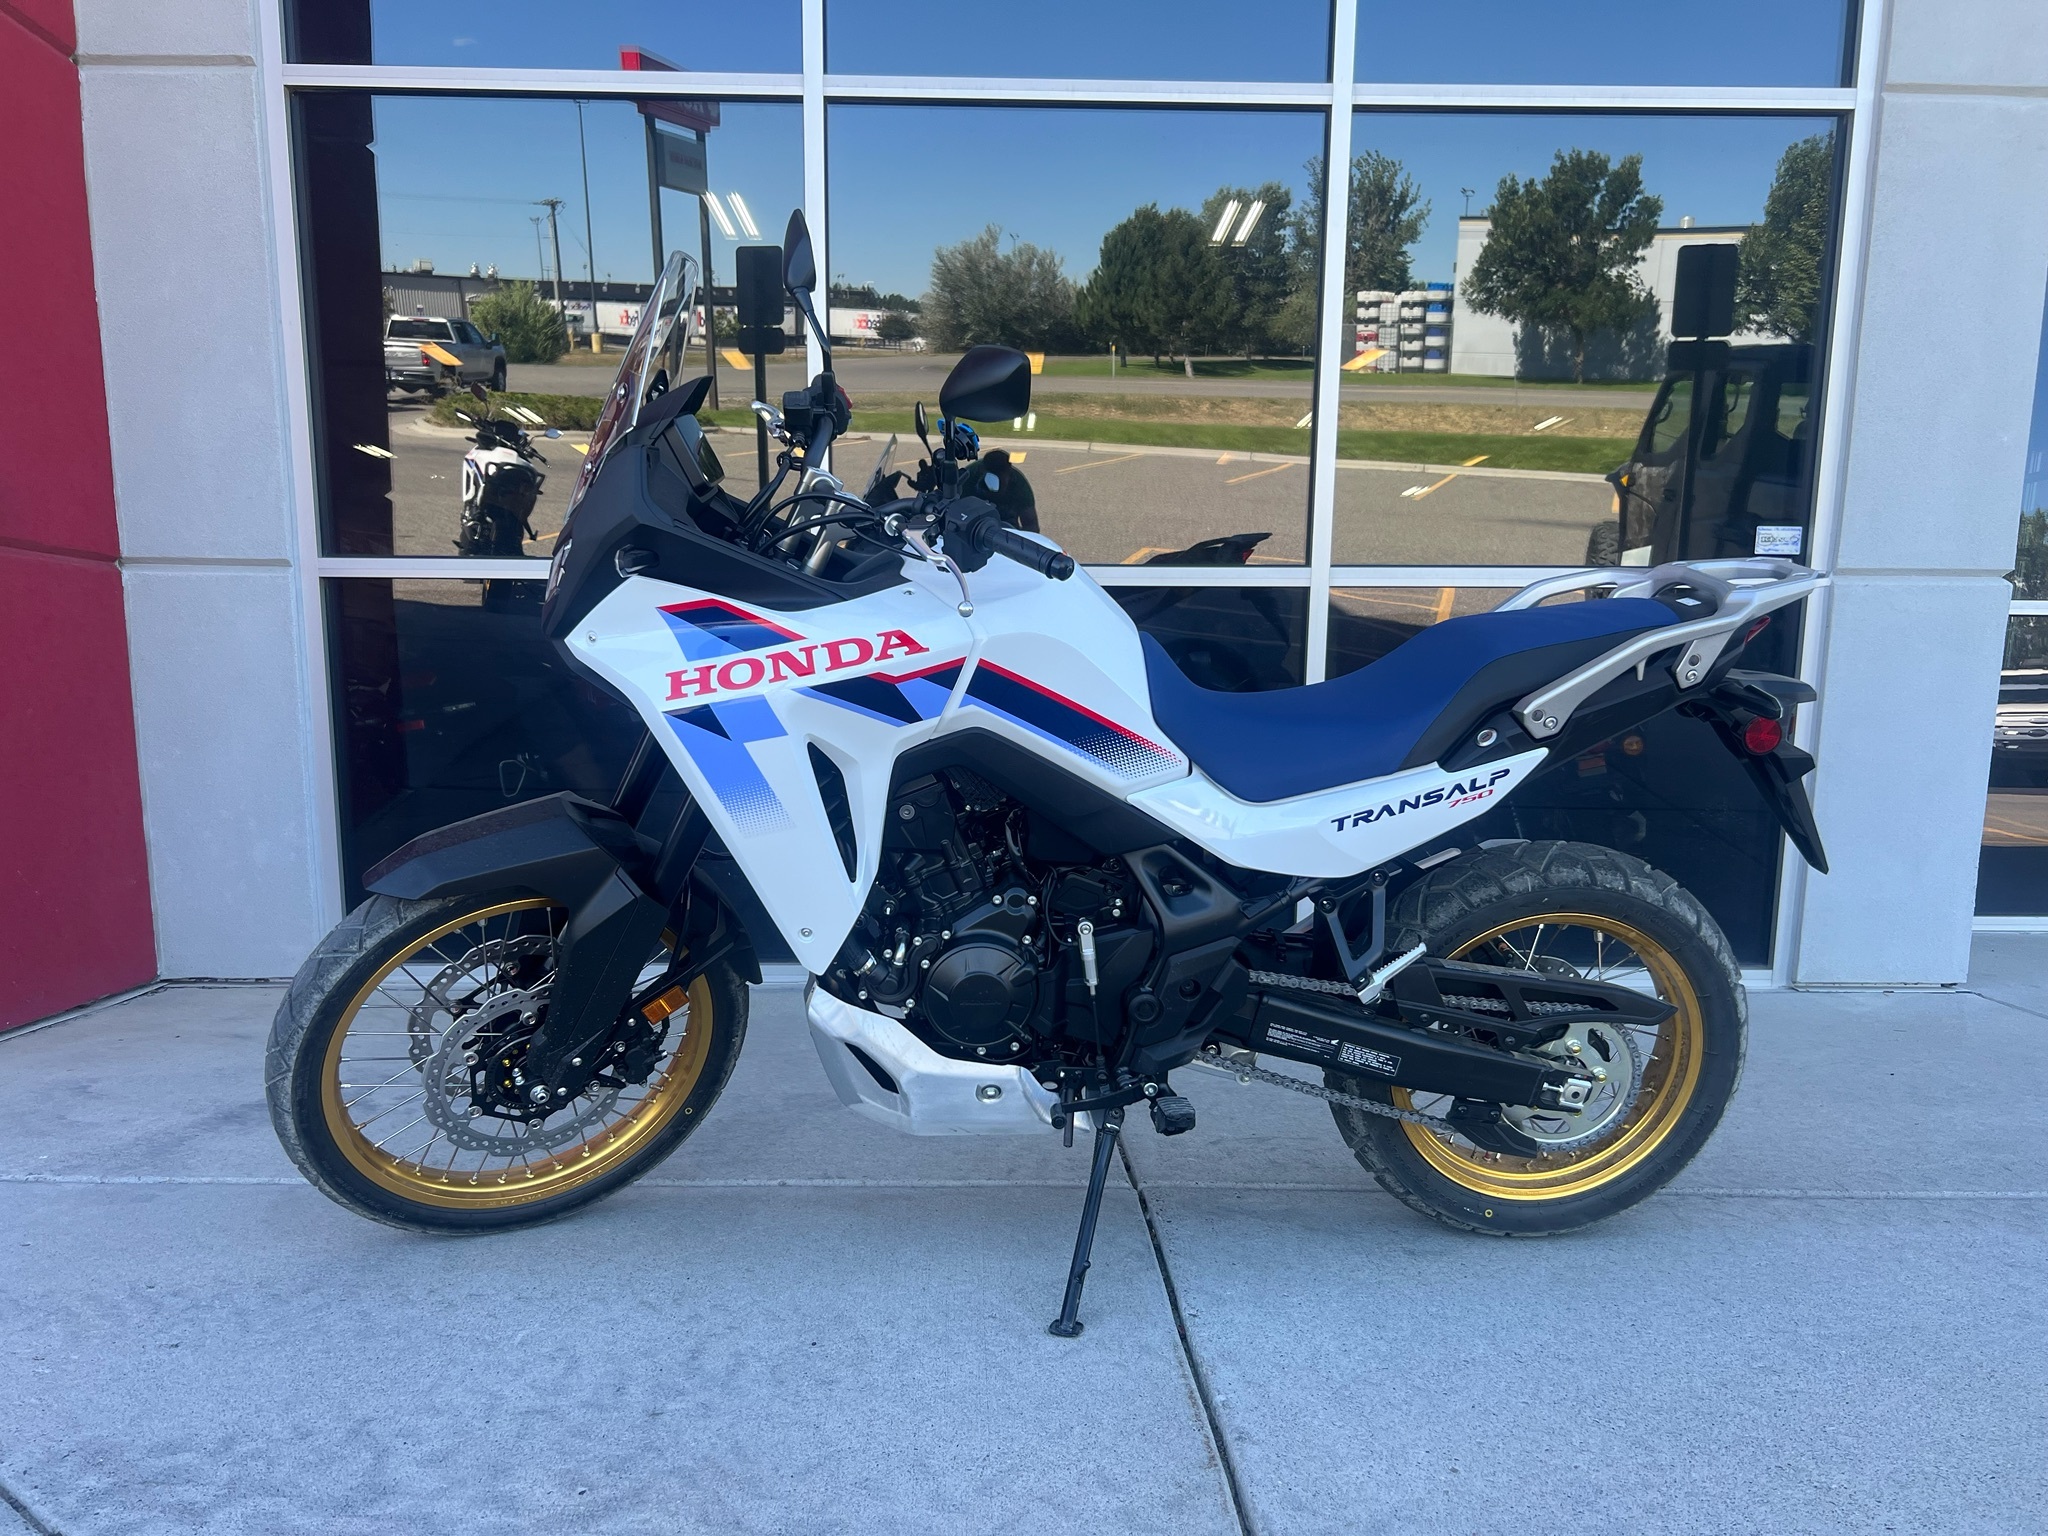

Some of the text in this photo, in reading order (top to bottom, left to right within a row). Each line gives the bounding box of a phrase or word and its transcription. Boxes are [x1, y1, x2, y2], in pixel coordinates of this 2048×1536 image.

[665, 628, 930, 702] HONDA
[1330, 768, 1511, 832] TRANSALP
[1447, 788, 1494, 809] 750
